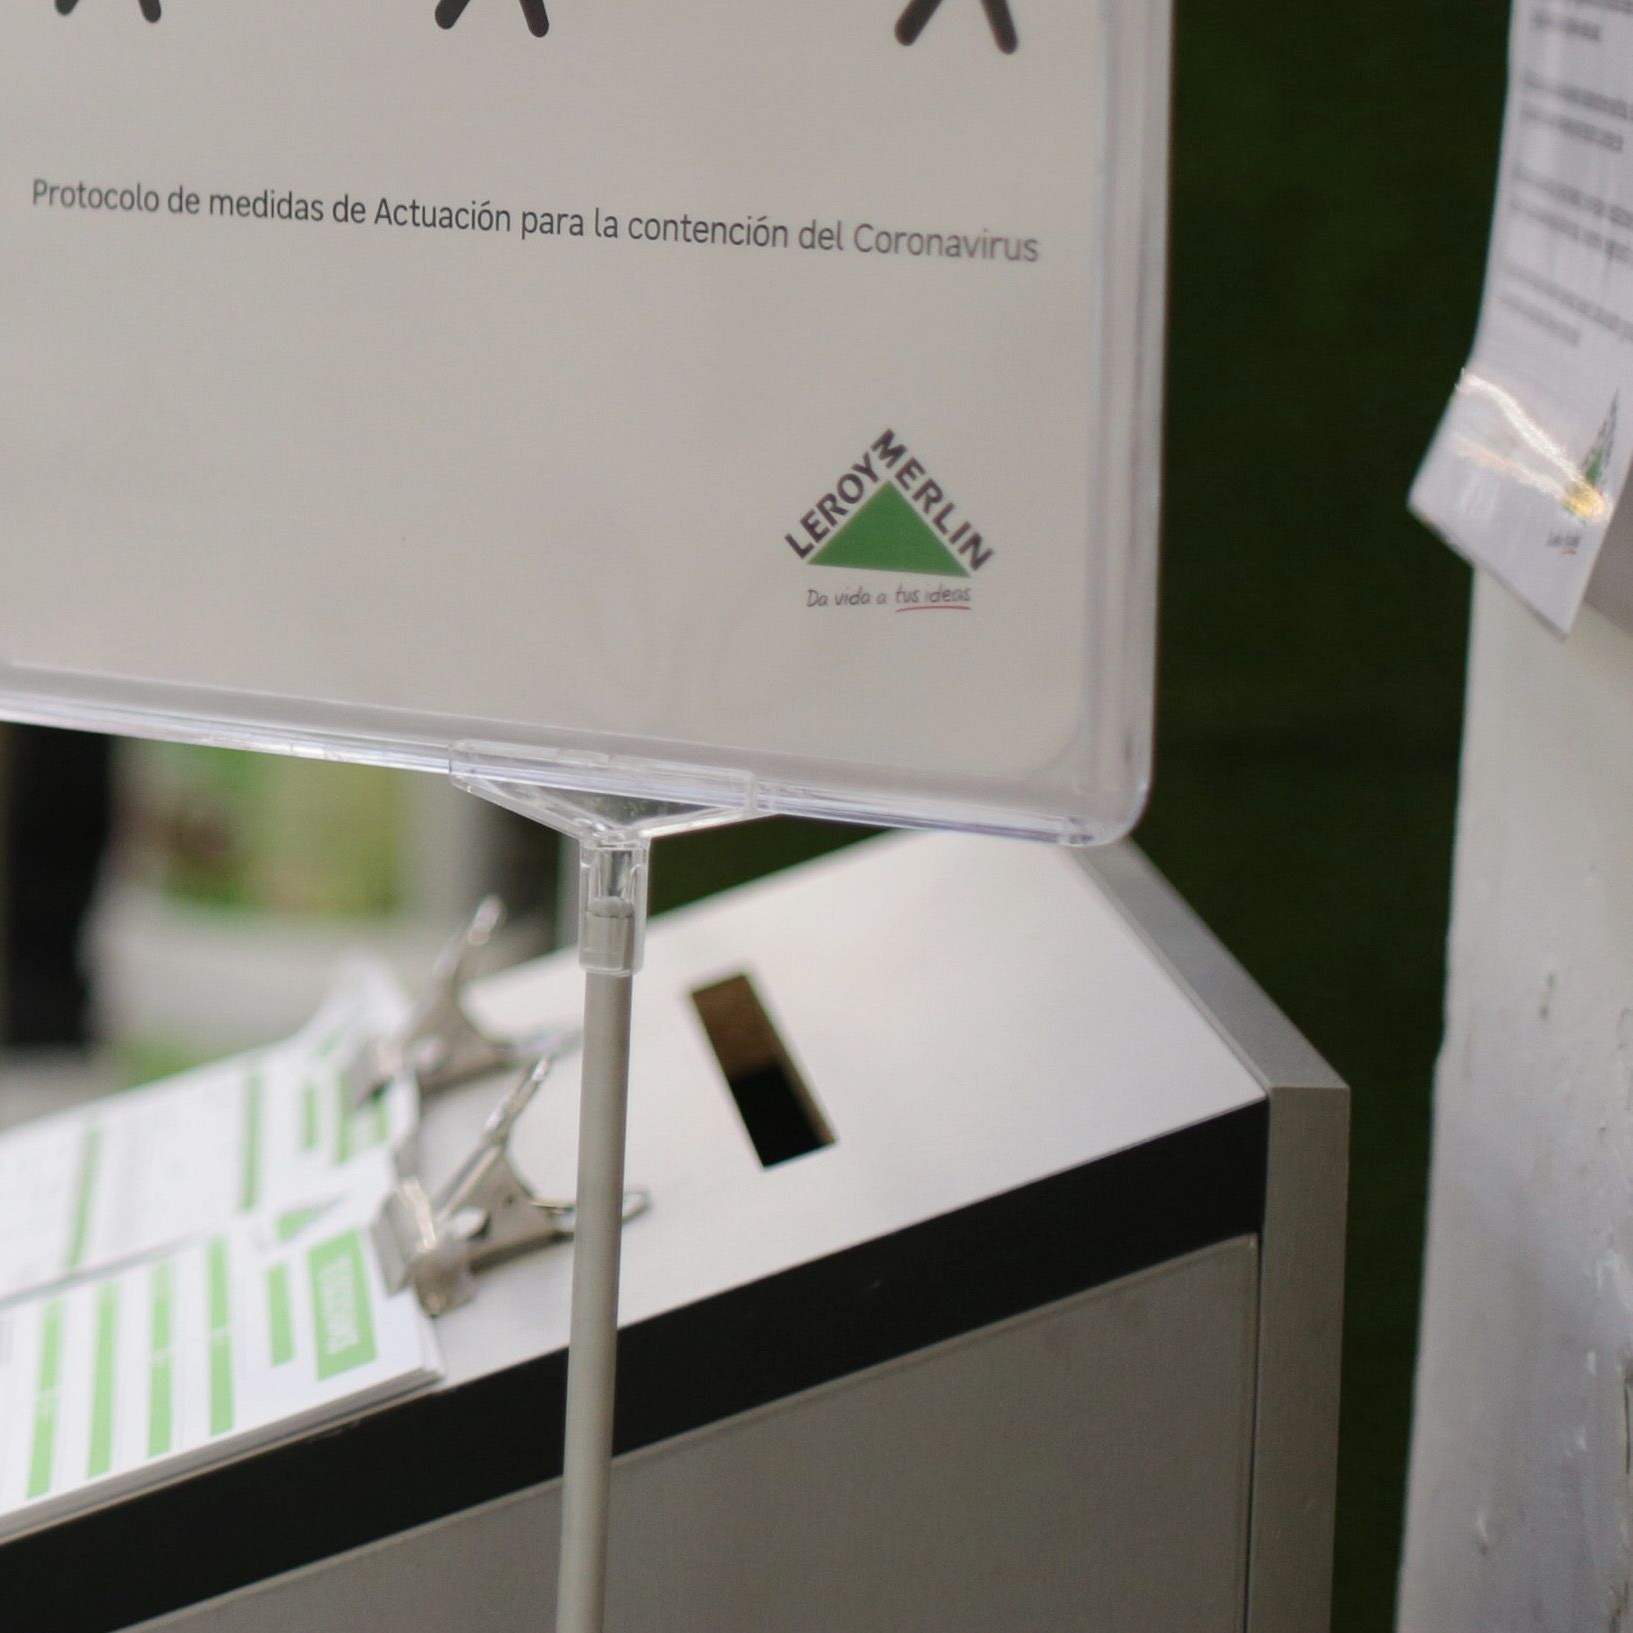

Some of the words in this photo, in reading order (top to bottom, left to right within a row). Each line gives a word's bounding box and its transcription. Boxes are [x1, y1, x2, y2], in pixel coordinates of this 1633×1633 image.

[32, 177, 161, 214] Protocolo
[166, 183, 201, 216] de
[208, 188, 325, 223] medidas
[331, 192, 367, 225] de
[373, 196, 511, 233] Actuación
[521, 210, 585, 241] para
[594, 206, 619, 240] la
[627, 213, 789, 249] contención
[797, 218, 845, 252] del
[853, 222, 1039, 263] Coronavirus
[783, 451, 880, 560] LEROY
[869, 428, 996, 572] MERLIN
[806, 588, 829, 608] Da
[835, 585, 872, 607] vida
[876, 592, 887, 605] a
[895, 583, 921, 604] tus
